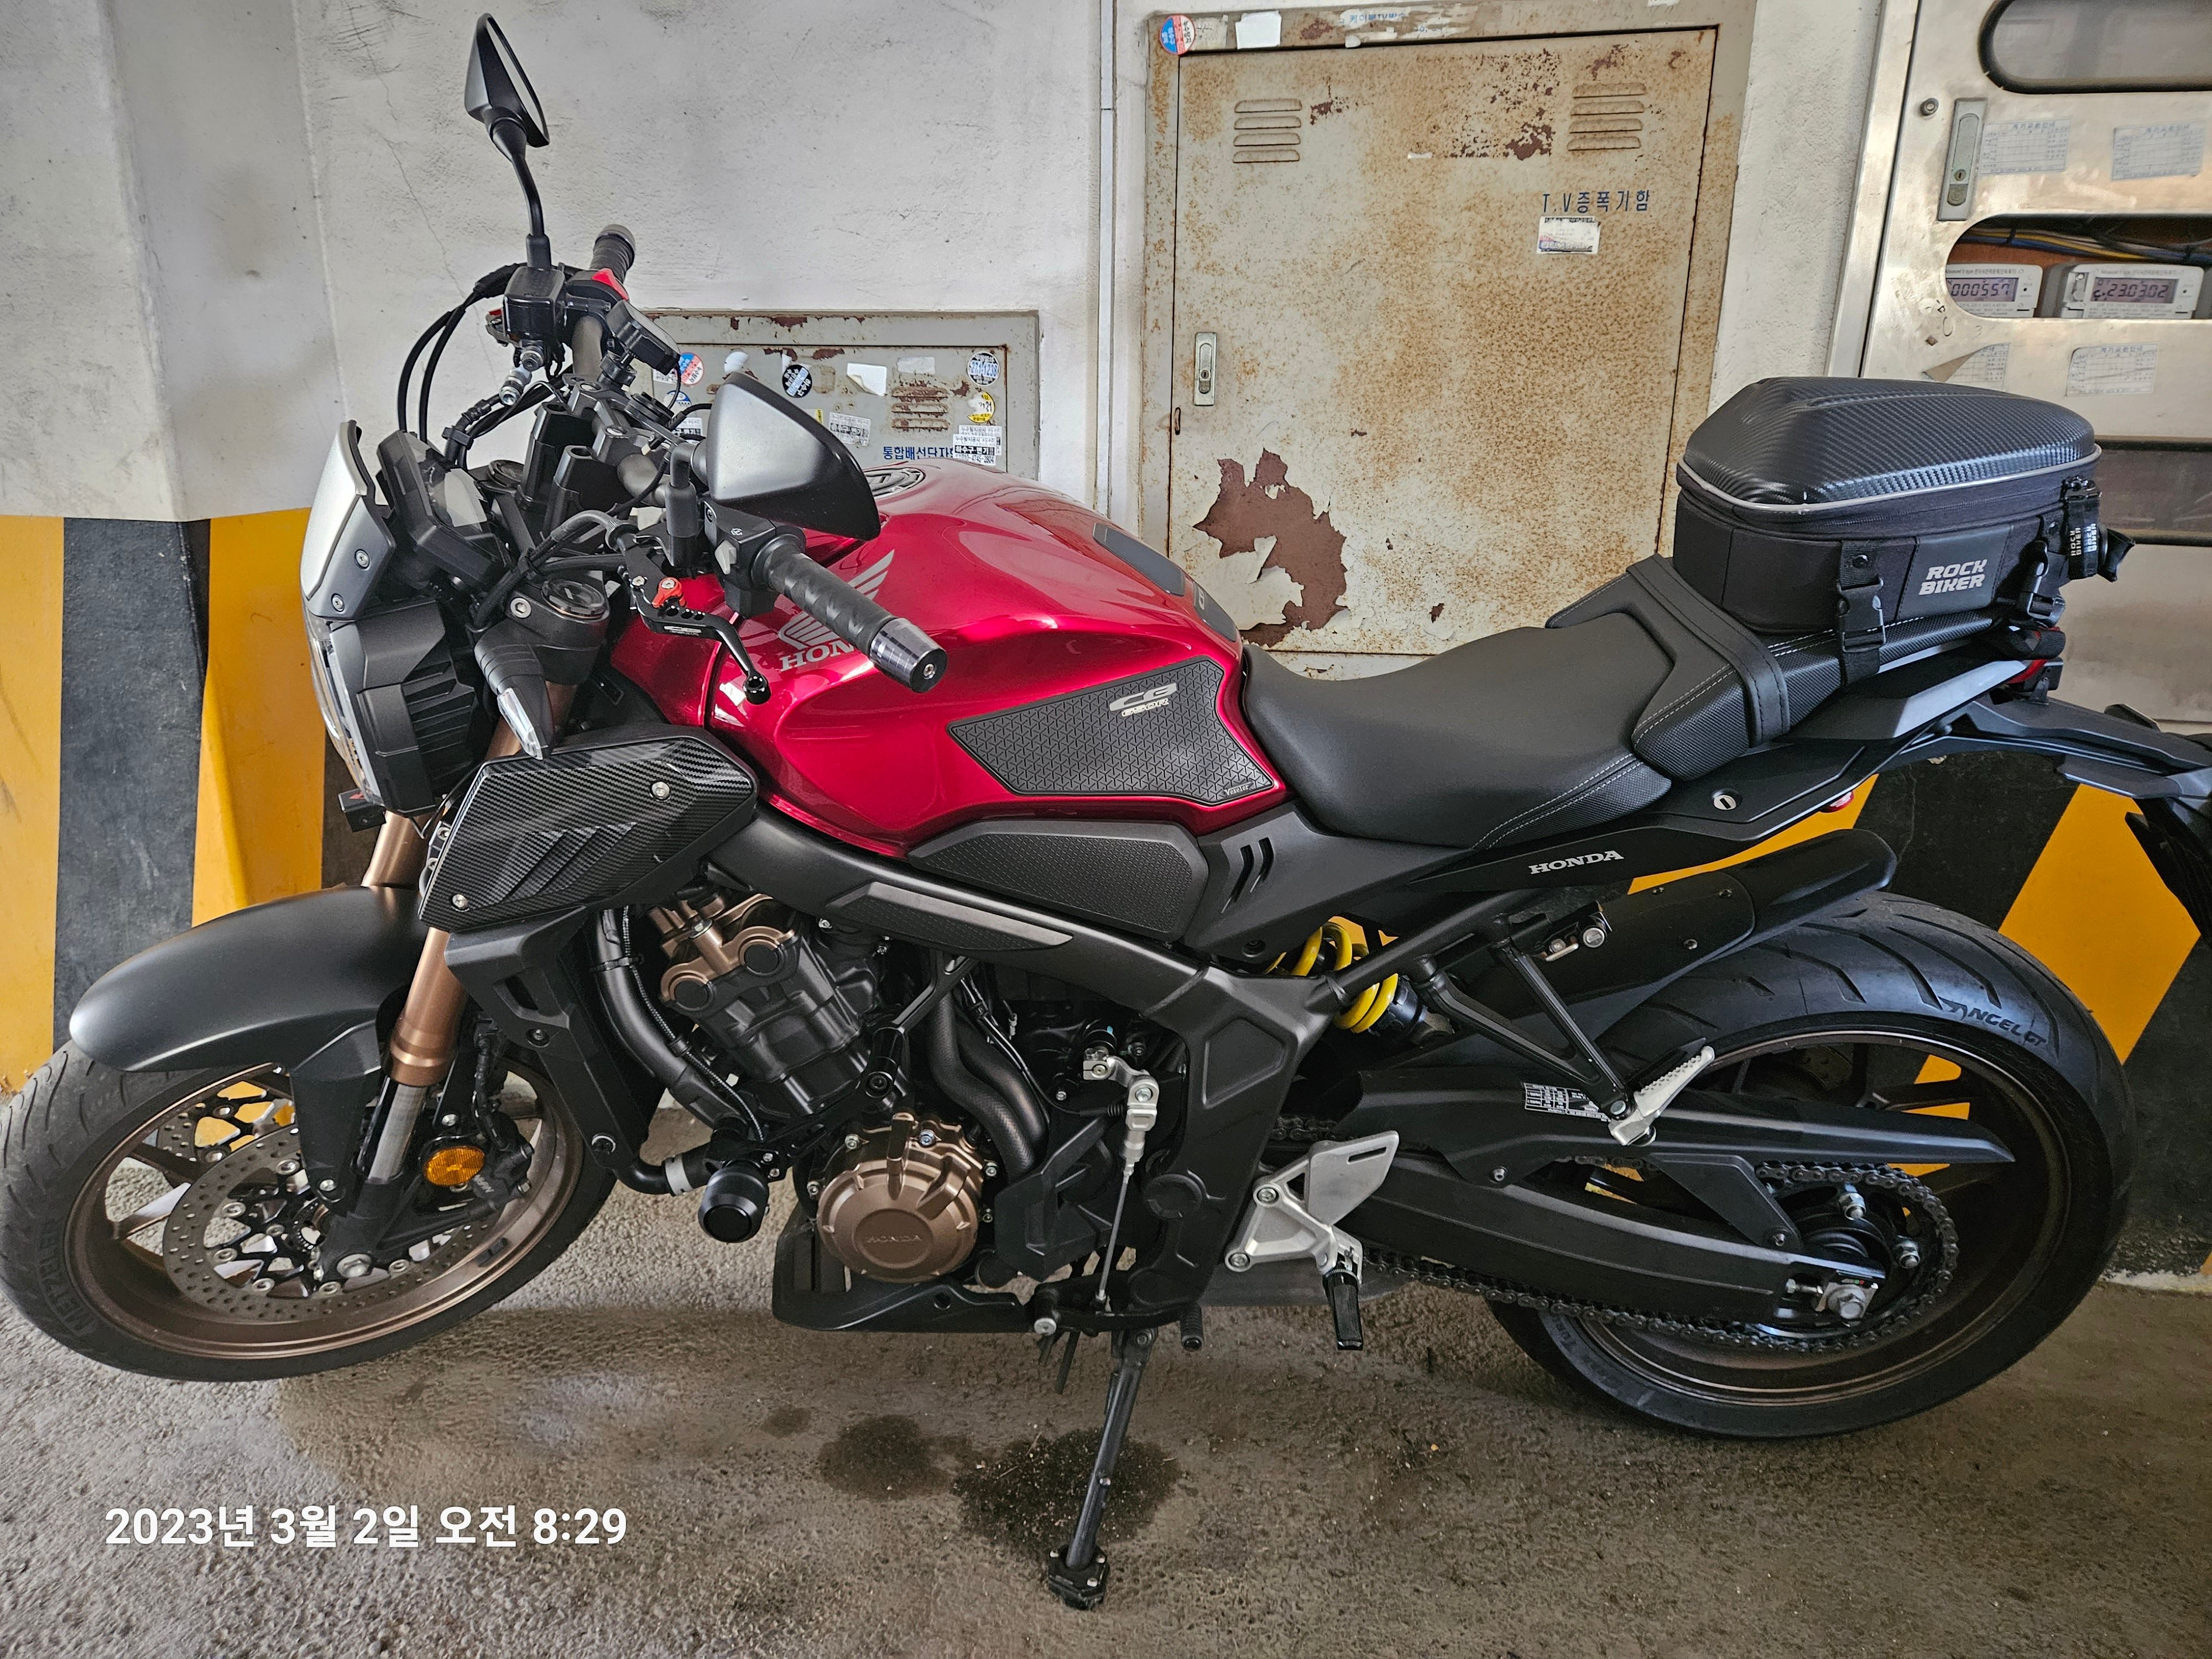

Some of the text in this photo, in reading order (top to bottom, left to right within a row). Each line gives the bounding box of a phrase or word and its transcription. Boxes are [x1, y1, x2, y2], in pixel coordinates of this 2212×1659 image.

[1926, 559, 1987, 580] ROCK
[1918, 573, 1985, 596] BIKER
[780, 640, 854, 672] HON
[1528, 850, 1624, 874] HONDA
